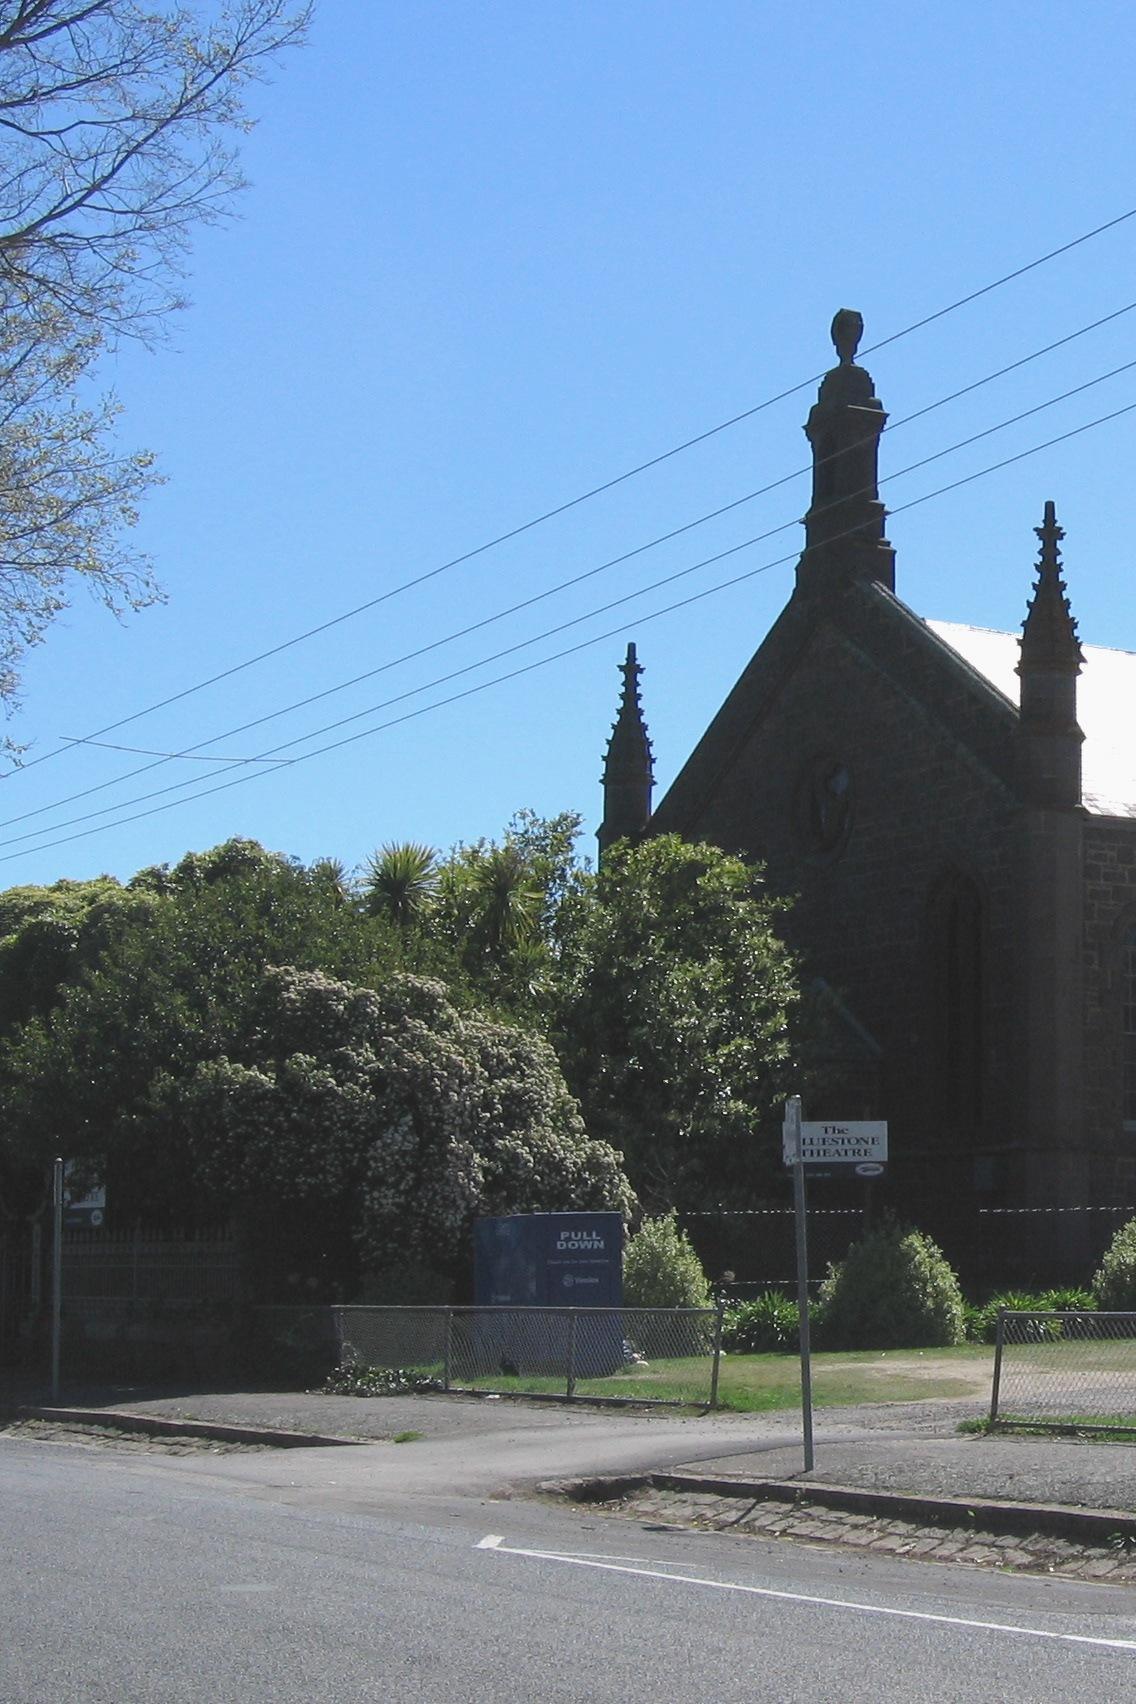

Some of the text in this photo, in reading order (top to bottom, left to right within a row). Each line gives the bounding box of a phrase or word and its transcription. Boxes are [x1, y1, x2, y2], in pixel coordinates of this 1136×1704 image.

[822, 1125, 848, 1135] The
[801, 1136, 880, 1146] LUESTONE
[801, 1148, 873, 1158] THEATRE
[560, 1231, 601, 1240] PULL
[556, 1240, 605, 1250] DOWN
